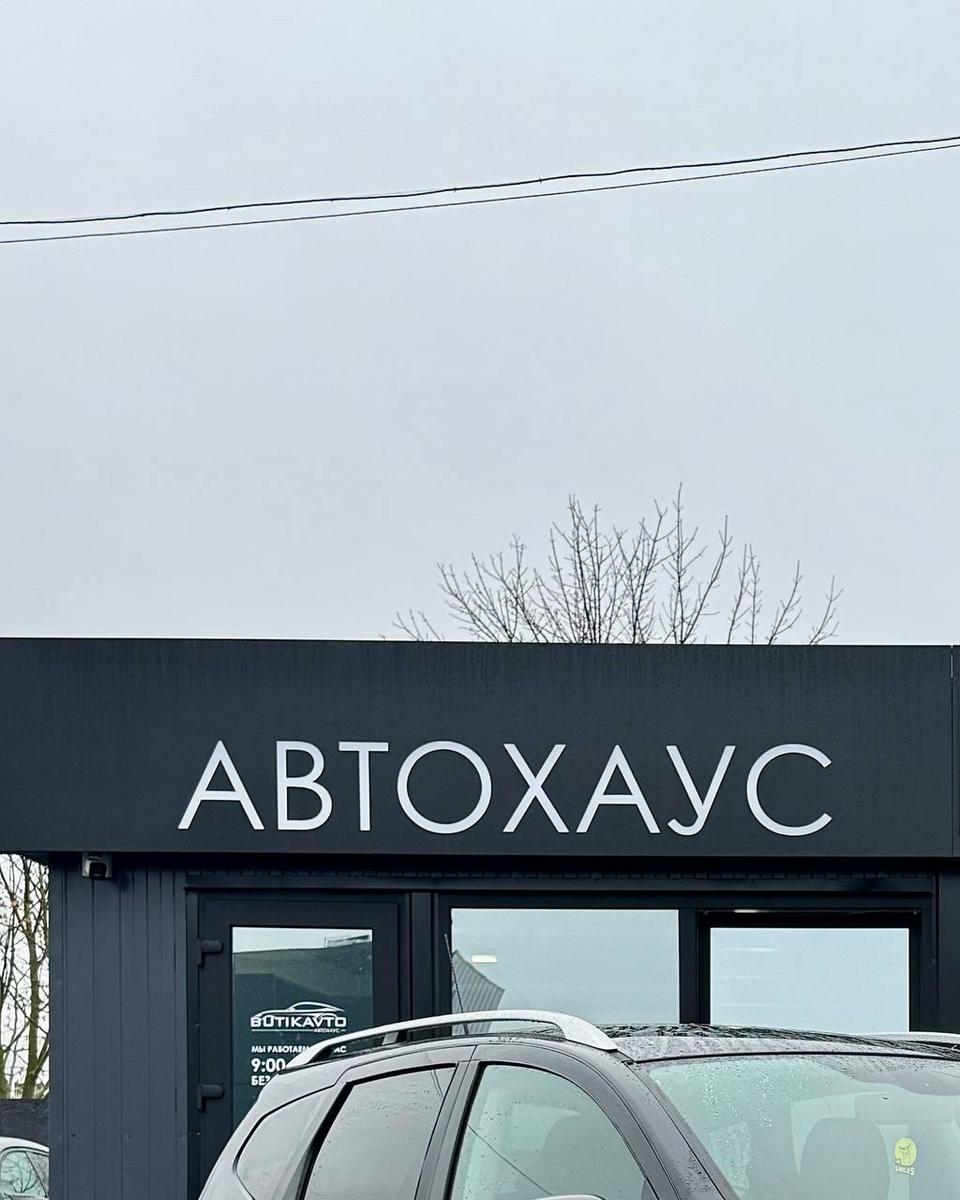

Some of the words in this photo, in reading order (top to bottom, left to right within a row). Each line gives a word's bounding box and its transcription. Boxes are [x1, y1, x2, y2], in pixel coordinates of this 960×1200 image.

[177, 740, 832, 837] АВТОХАУС
[250, 1016, 347, 1028] BUTIKAVTO
[251, 1045, 266, 1053] МЫ
[251, 1057, 286, 1073] 9:00
